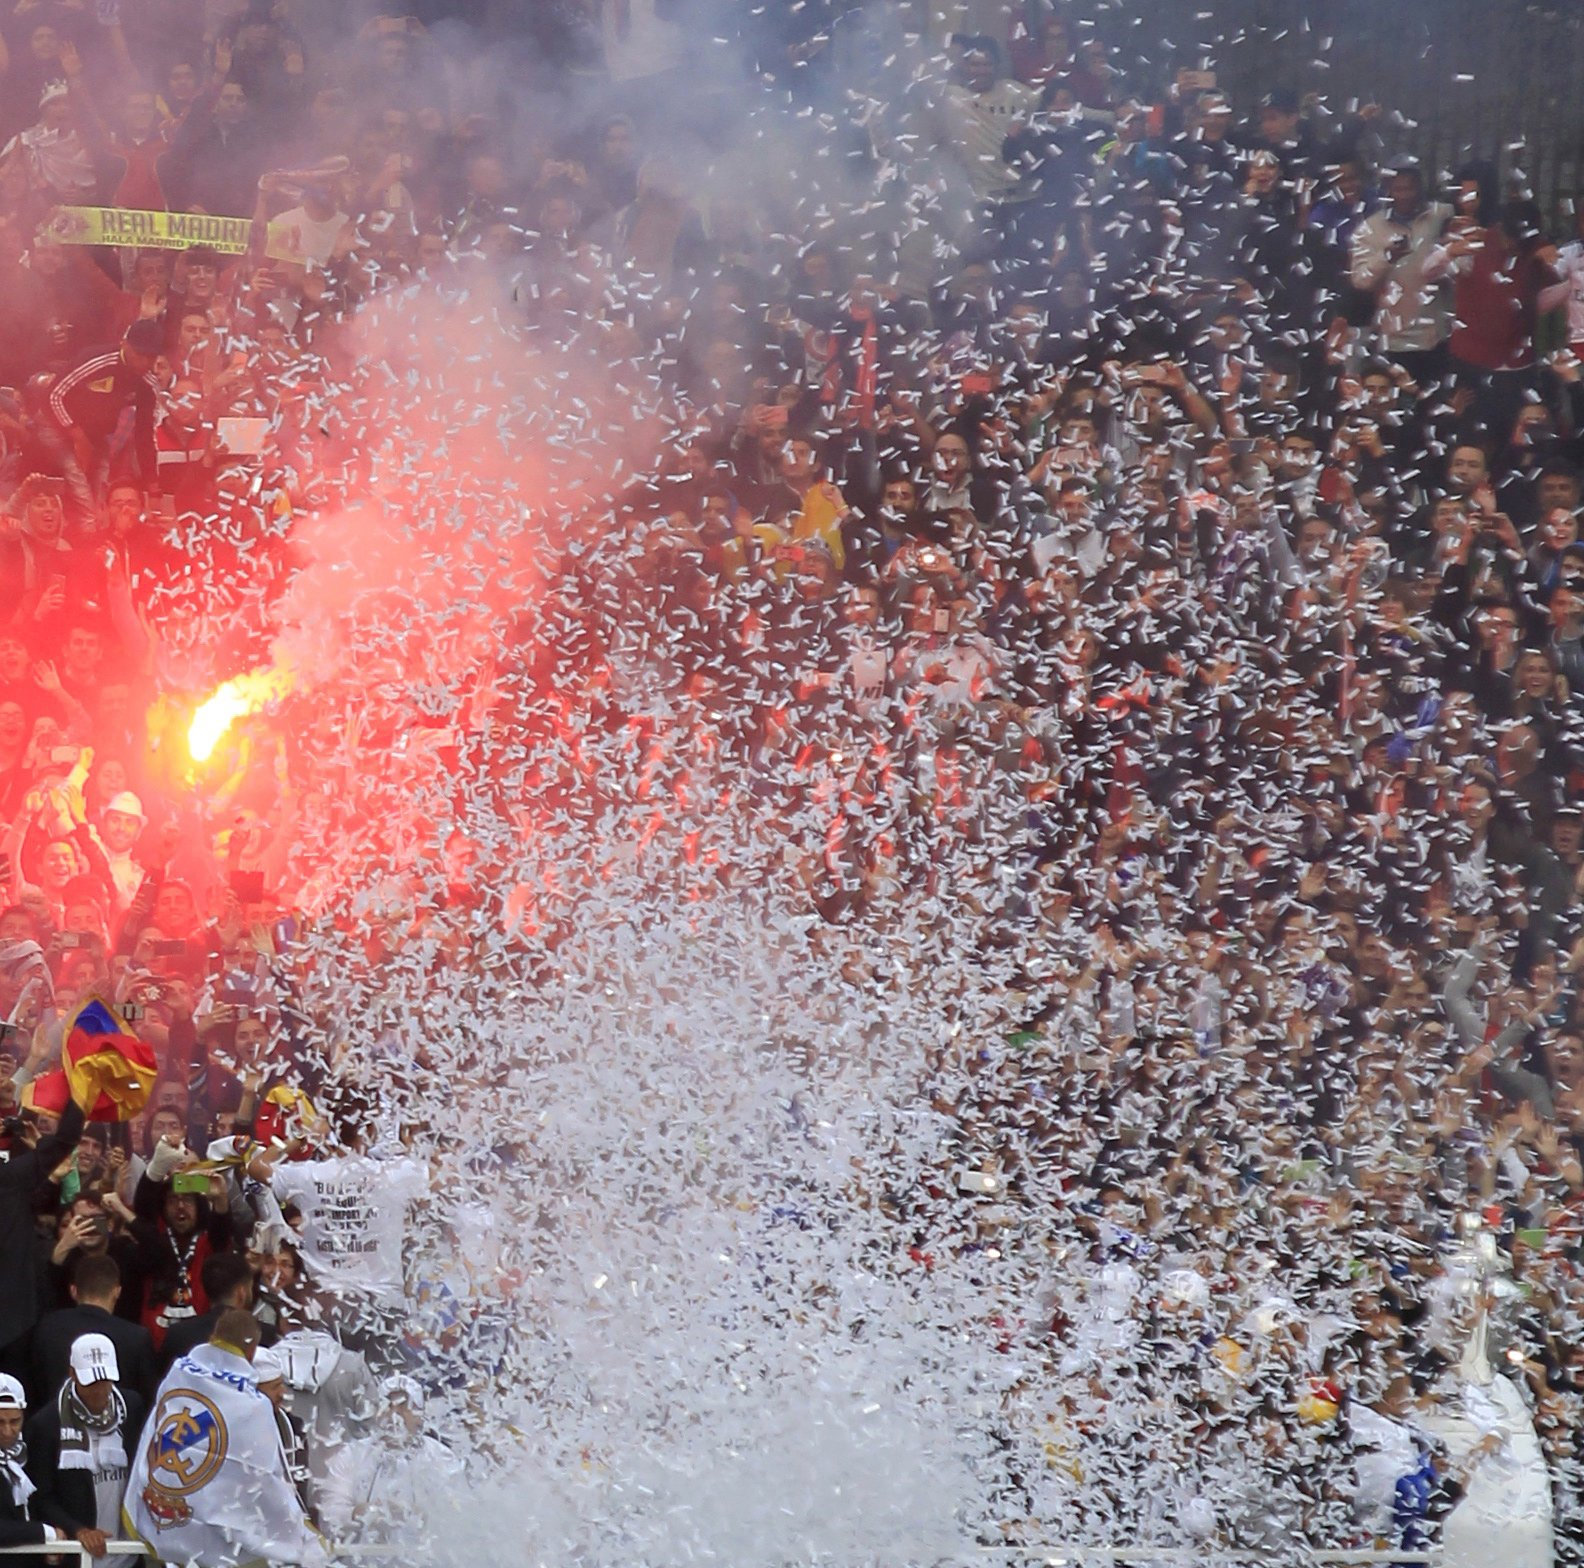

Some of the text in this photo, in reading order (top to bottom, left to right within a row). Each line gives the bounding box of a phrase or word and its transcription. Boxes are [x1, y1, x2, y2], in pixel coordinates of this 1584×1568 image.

[100, 210, 247, 243] REAL MADRI
[102, 235, 135, 244] HALA
